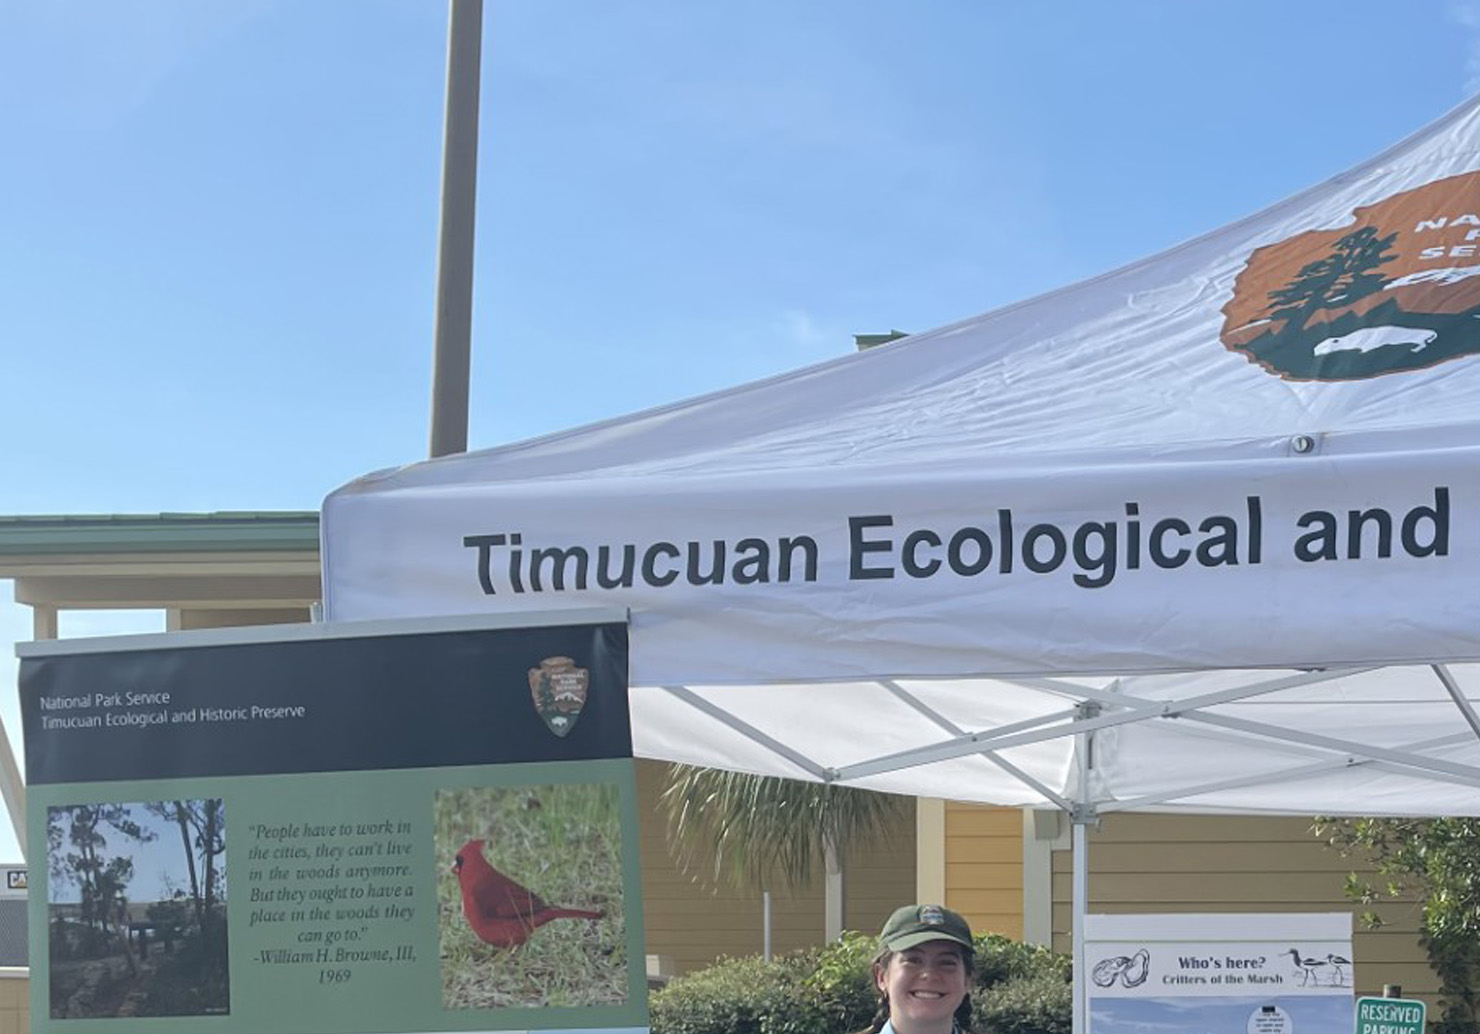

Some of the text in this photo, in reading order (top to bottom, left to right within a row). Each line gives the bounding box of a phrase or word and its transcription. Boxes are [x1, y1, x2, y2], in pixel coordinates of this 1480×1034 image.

[462, 532, 820, 595] Timucuan
[847, 495, 1262, 589] Ecological
[1293, 486, 1451, 563] and
[40, 691, 171, 710] National Park Service
[41, 705, 306, 729] Timucuan Ecological and Historic Preserve
[249, 820, 412, 842] "People have to work in
[249, 840, 413, 861] the cities, they can't live
[10, 872, 27, 888] CA
[249, 864, 413, 881] in the woods anymore.
[250, 883, 414, 904] But they ought to have a
[250, 904, 415, 927] place in the woods they
[297, 930, 322, 943] can
[325, 930, 342, 945] go
[253, 948, 313, 964] -William
[316, 948, 333, 963] H.
[335, 947, 394, 963] Browne,
[1178, 956, 1267, 969] Who's here?
[318, 969, 352, 984] 1969
[1162, 973, 1283, 984] Critters of the Marsh
[1361, 1003, 1420, 1023] RESERVED
